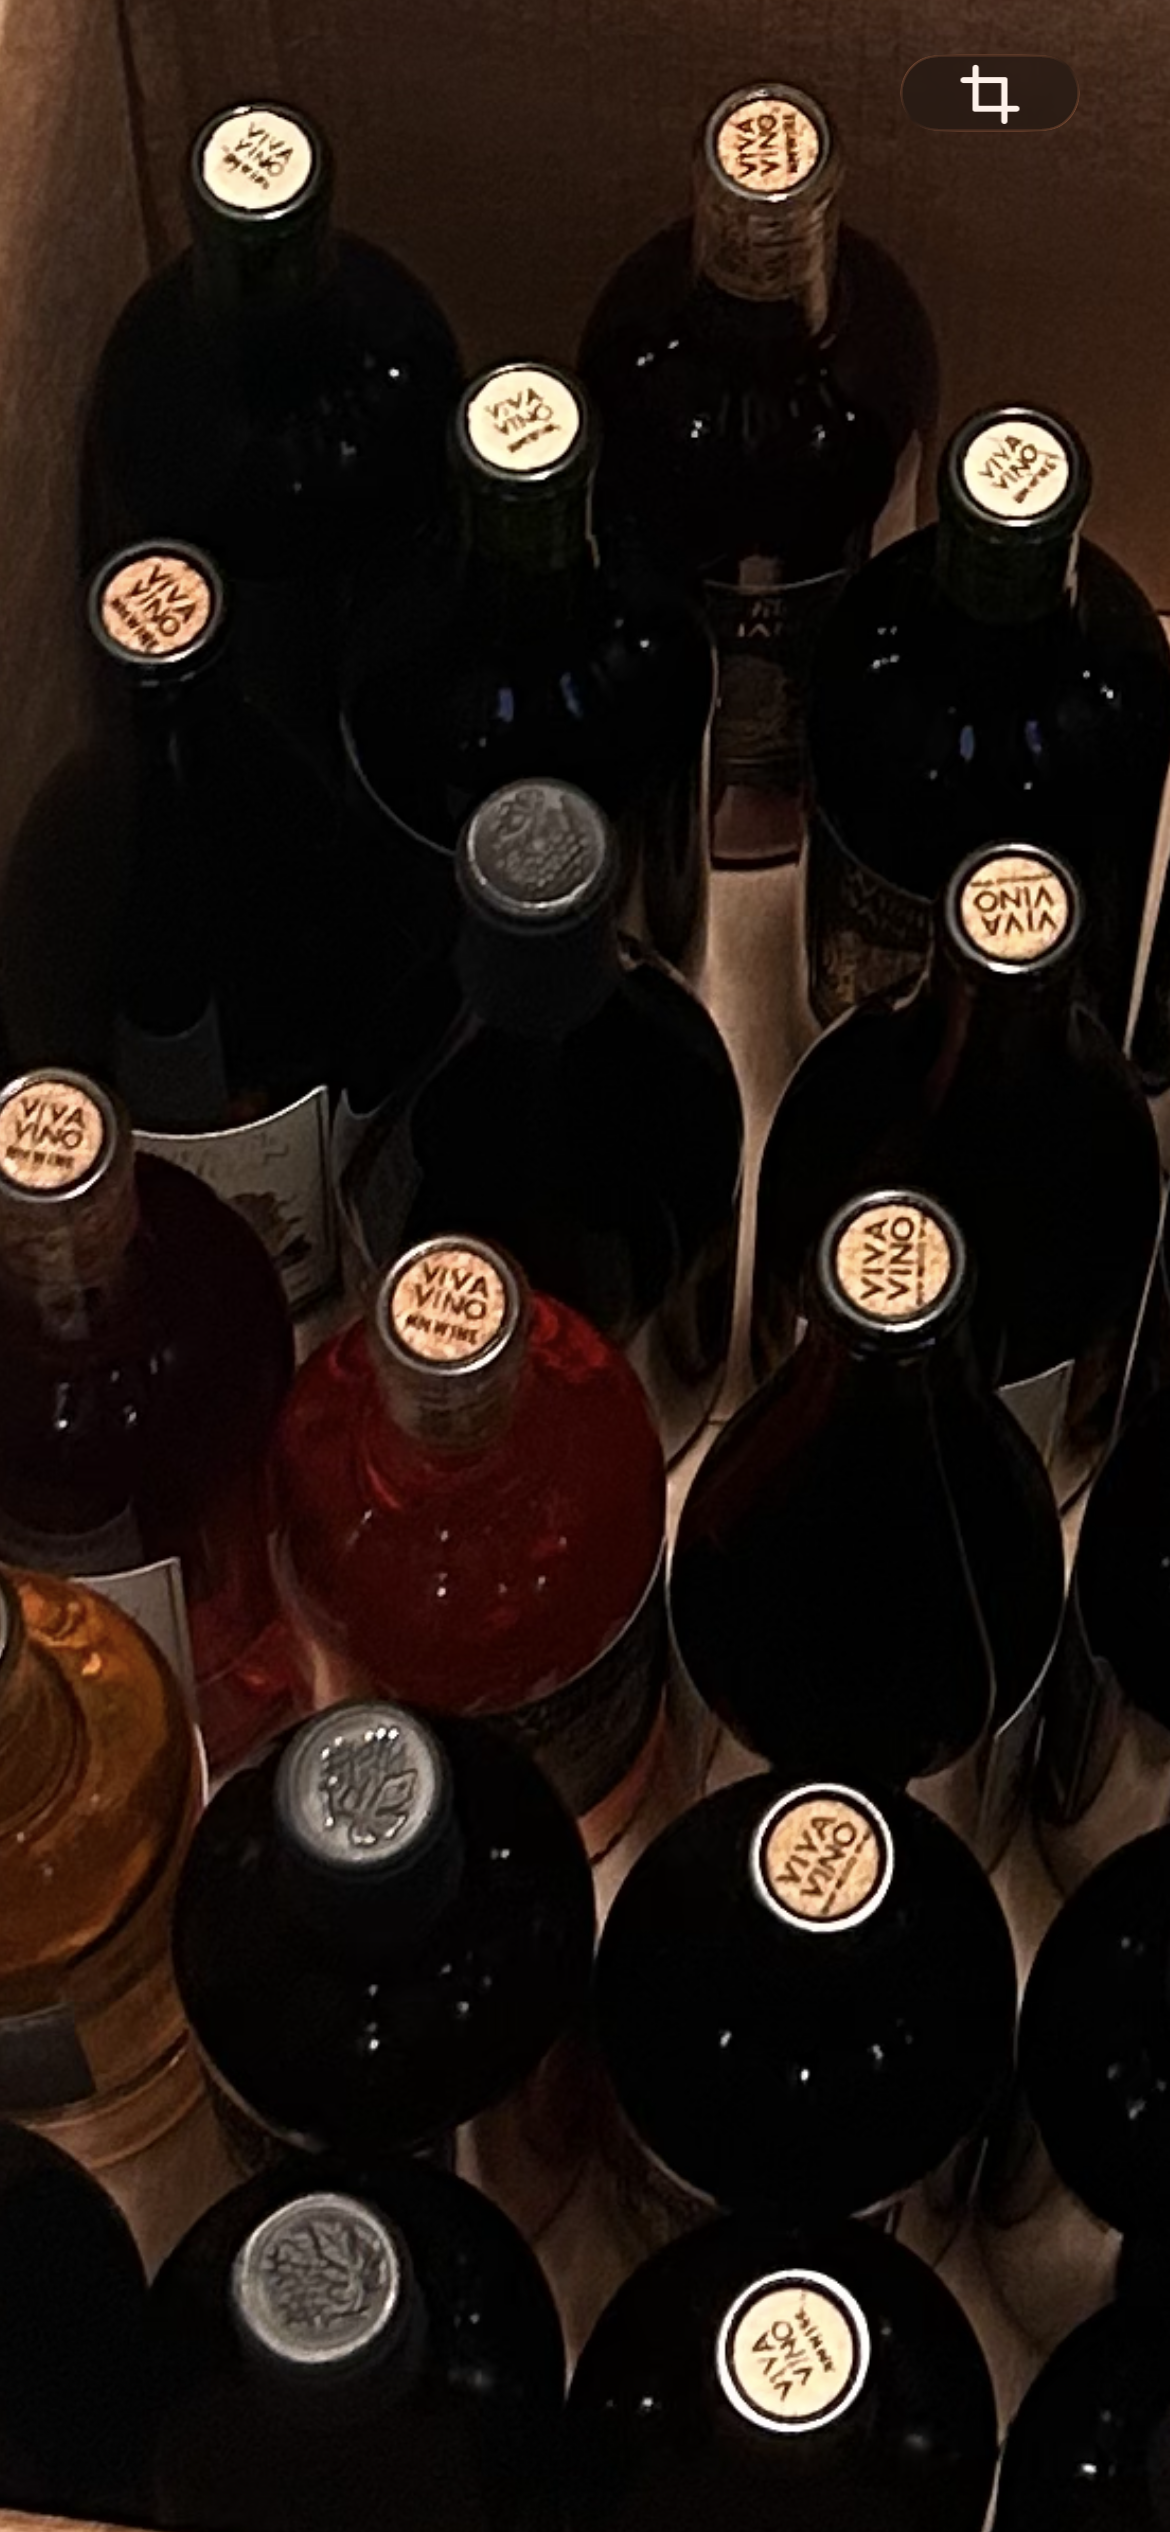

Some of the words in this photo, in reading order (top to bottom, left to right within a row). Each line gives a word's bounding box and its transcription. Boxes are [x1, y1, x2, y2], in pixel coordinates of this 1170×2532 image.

[235, 139, 284, 177] VINO
[248, 121, 293, 165] VIVA
[735, 117, 757, 178] VIVA
[757, 114, 780, 177] VINO
[484, 387, 543, 420] VIVA
[493, 403, 553, 435] VINO
[977, 435, 1023, 479] VIVA
[990, 444, 1037, 490] VINO
[124, 579, 180, 637] VINO
[148, 563, 197, 624] VIVA
[973, 885, 1054, 913] VINO
[981, 910, 1057, 936] VIVA
[15, 1118, 83, 1150] VINO
[20, 1096, 86, 1130] VIVA
[423, 1261, 488, 1300] VIVA
[860, 1219, 889, 1301] VIVA
[886, 1216, 915, 1301] VINO
[415, 1283, 487, 1321] VINO
[776, 1816, 838, 1884] VIVA
[800, 1821, 857, 1897] VINO
[752, 2330, 793, 2403] VIVA
[771, 2320, 813, 2387] VINO
